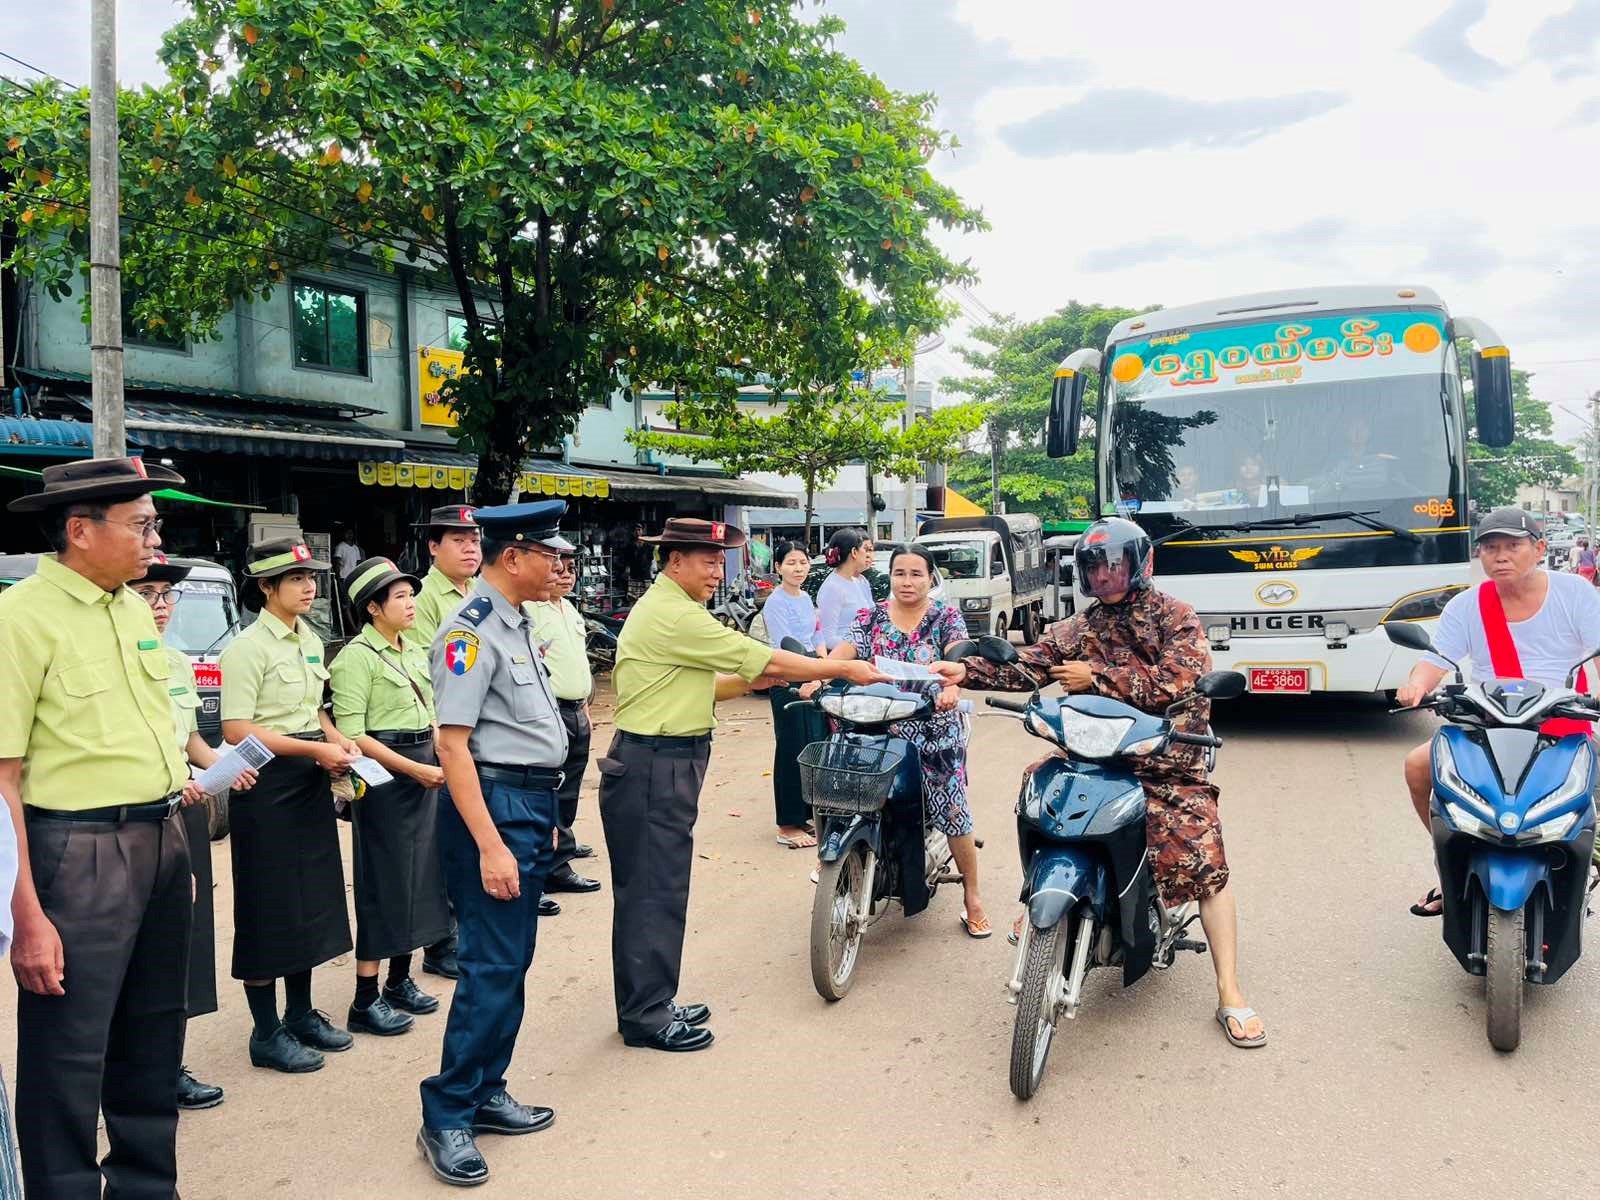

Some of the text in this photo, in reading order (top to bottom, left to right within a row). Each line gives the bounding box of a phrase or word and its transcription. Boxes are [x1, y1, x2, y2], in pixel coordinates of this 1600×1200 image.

[1260, 550, 1290, 561] VIP
[1275, 561, 1298, 569] CLASS
[1231, 615, 1325, 630] HIGER
[1253, 674, 1303, 687] 4E-3860
[205, 702, 216, 710] RE
